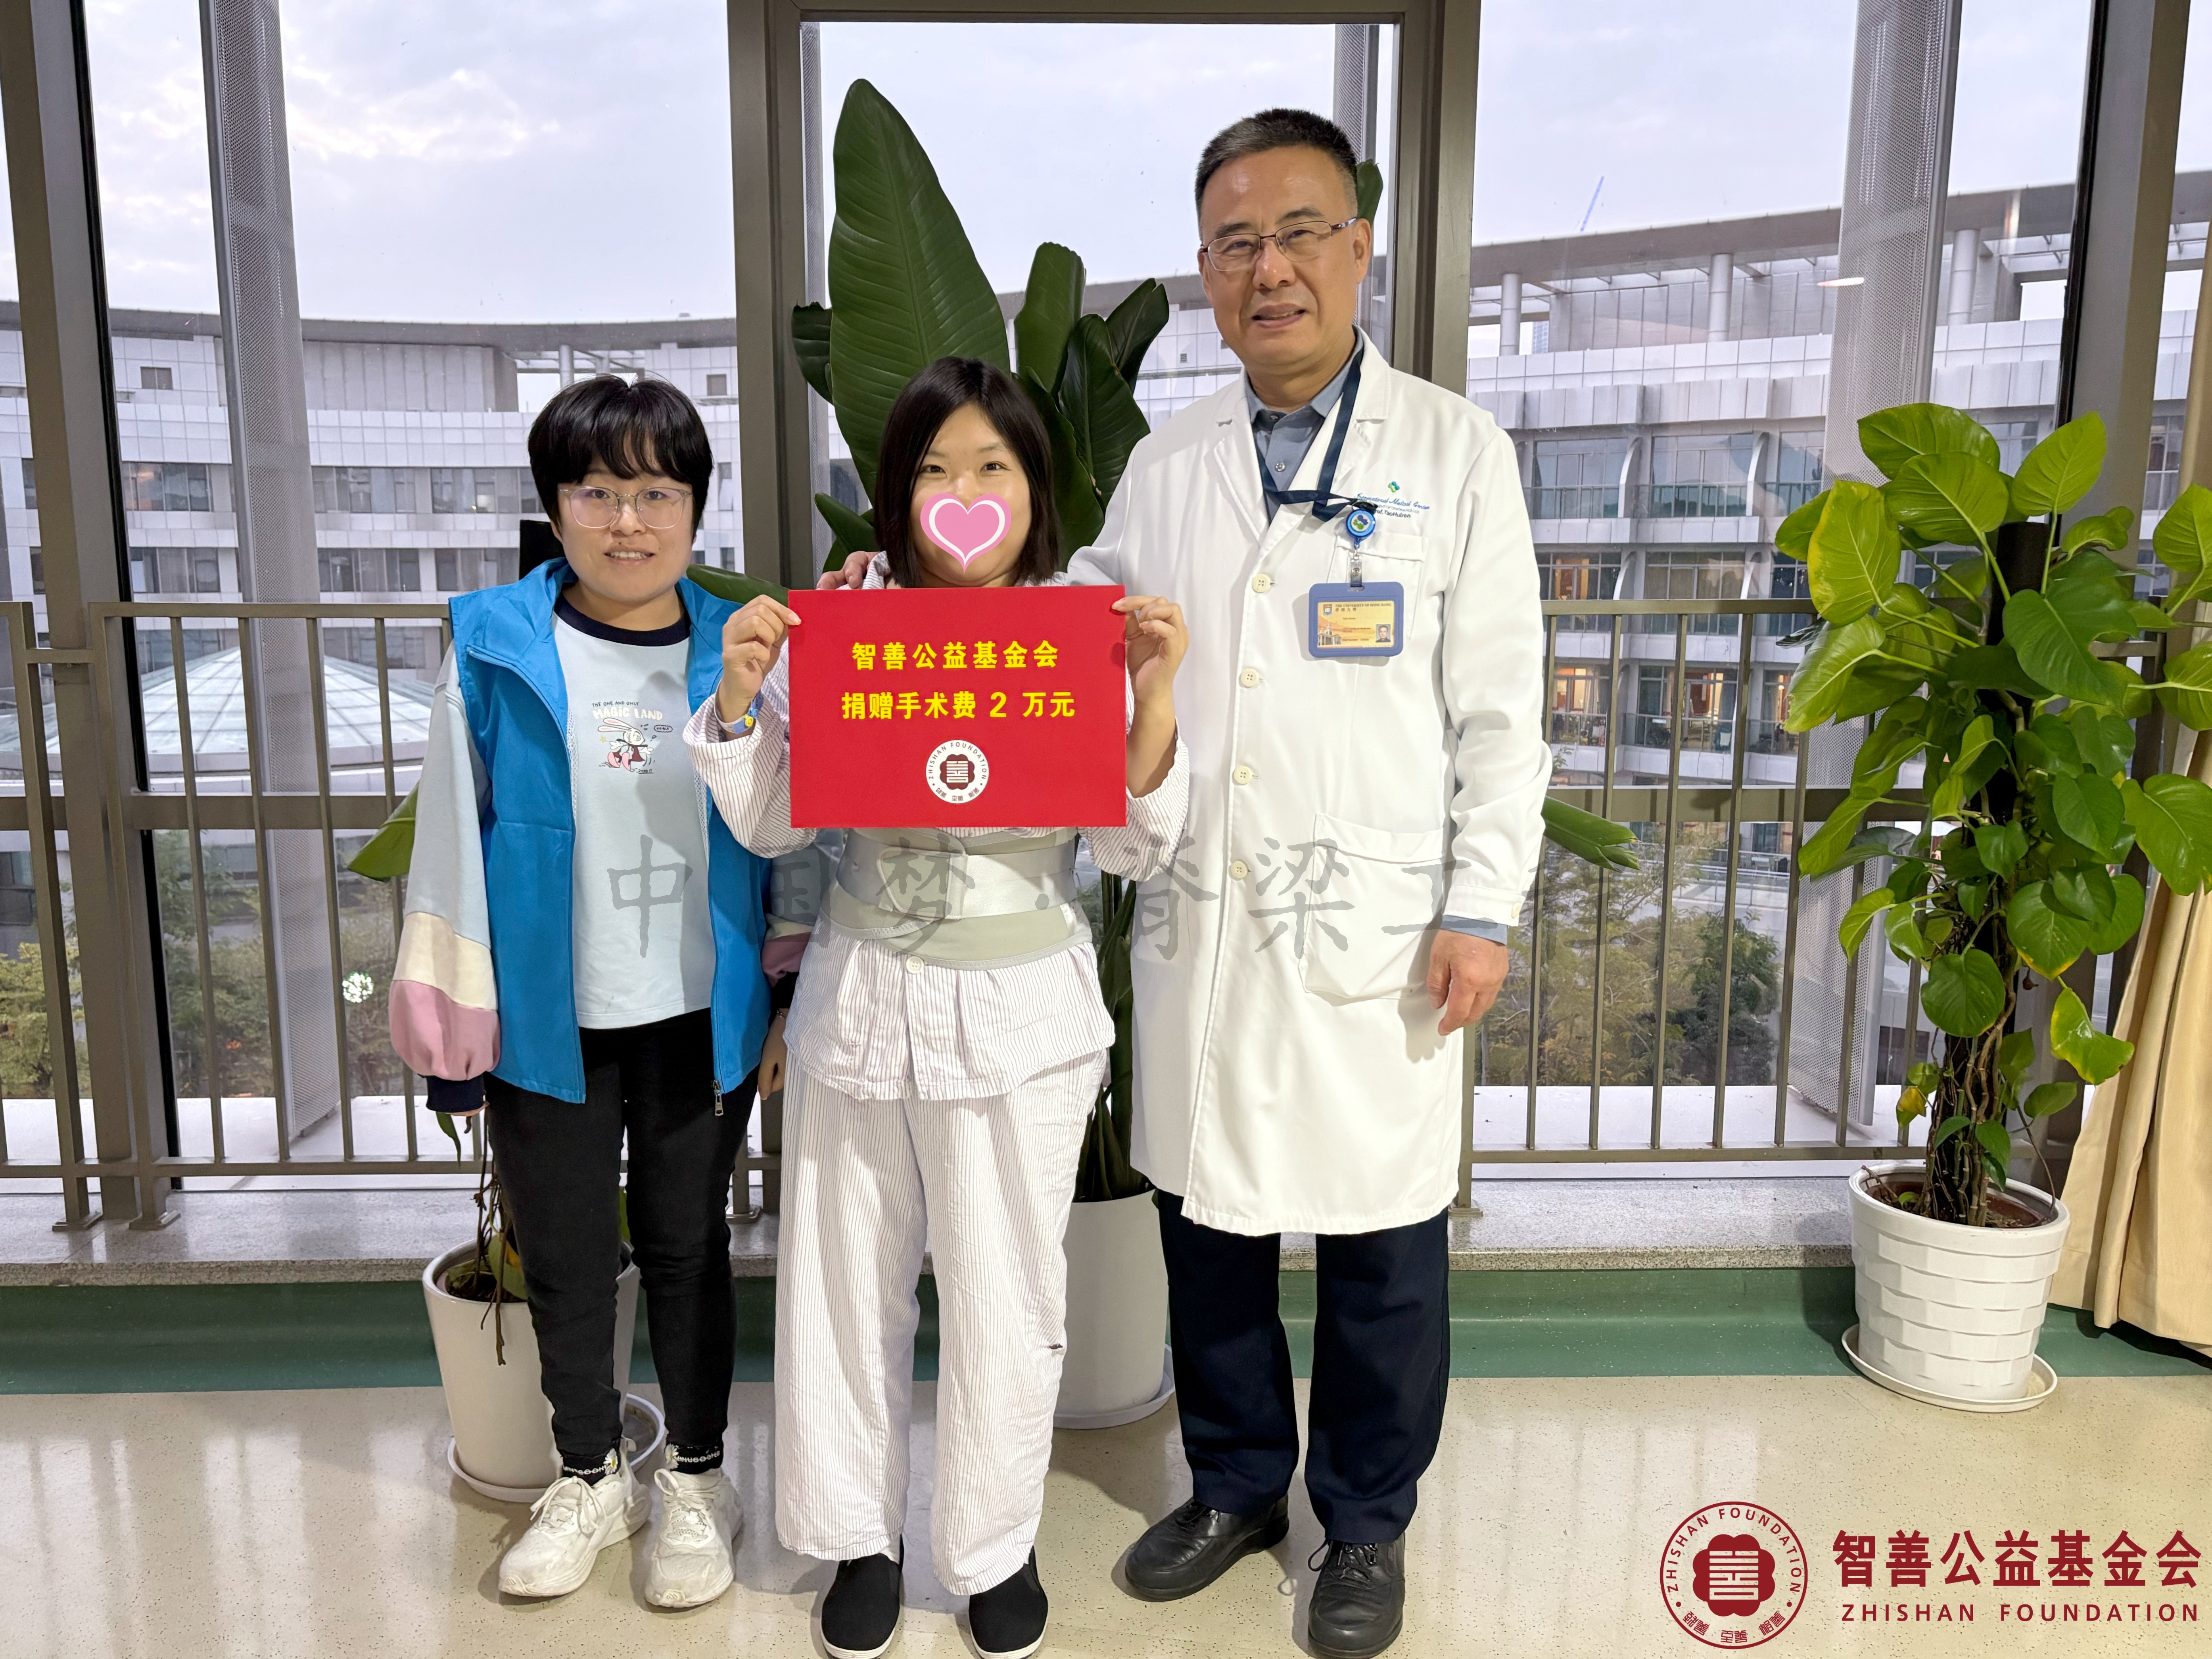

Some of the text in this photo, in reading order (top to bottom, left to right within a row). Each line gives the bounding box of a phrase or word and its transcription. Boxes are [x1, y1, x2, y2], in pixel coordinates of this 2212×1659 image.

[852, 641, 1057, 669] 智善公益基金会
[634, 708, 663, 721] LAND
[842, 691, 1074, 719] 捐赠手术费 2 万元
[928, 742, 987, 780] ZHISHAN FOUNDATION
